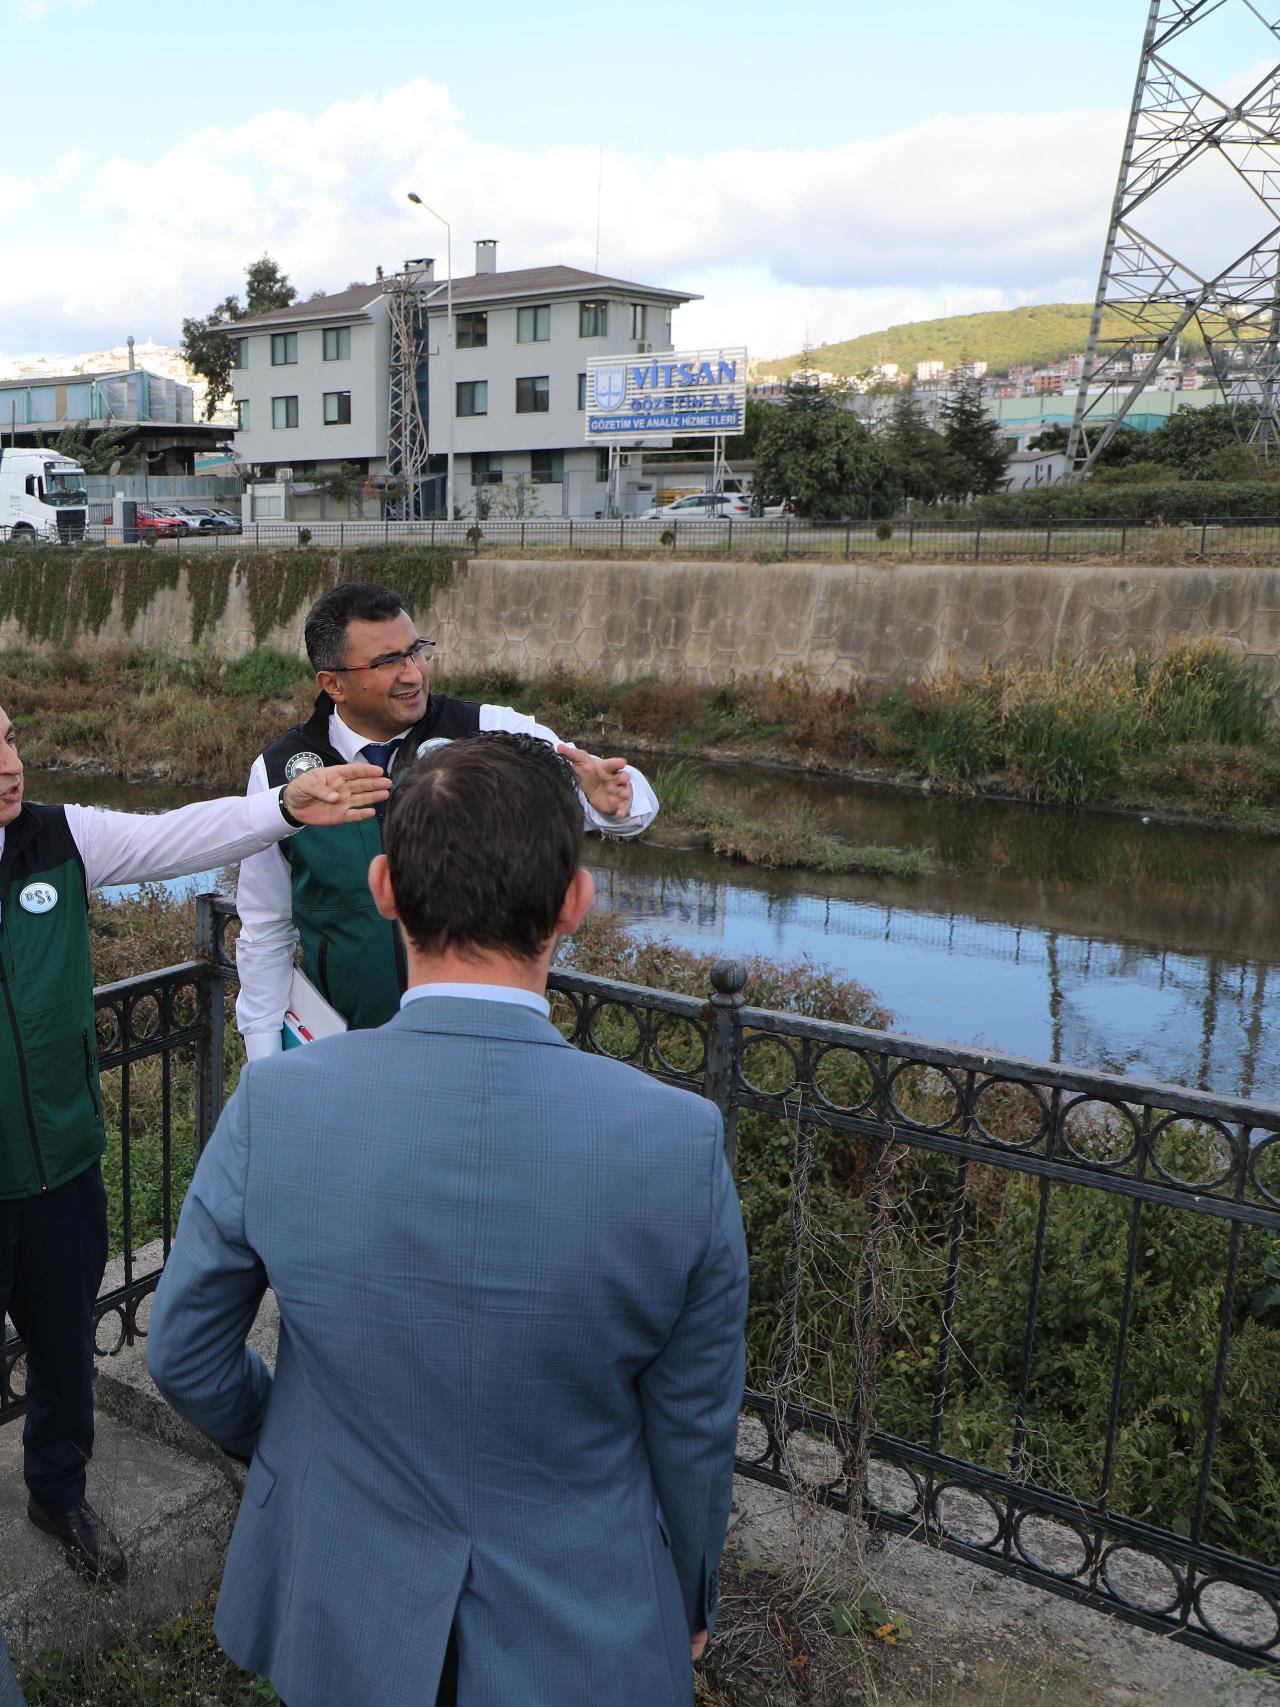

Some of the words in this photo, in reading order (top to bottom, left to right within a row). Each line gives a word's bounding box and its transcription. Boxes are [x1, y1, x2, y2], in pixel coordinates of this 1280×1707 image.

[631, 358, 737, 389] VİTSAN
[630, 394, 705, 412] GÖZETİM
[591, 418, 631, 431] GÖZETİM
[633, 417, 646, 429] VE
[647, 415, 679, 429] ANALİZ
[681, 413, 737, 426] HİZMETLERİ
